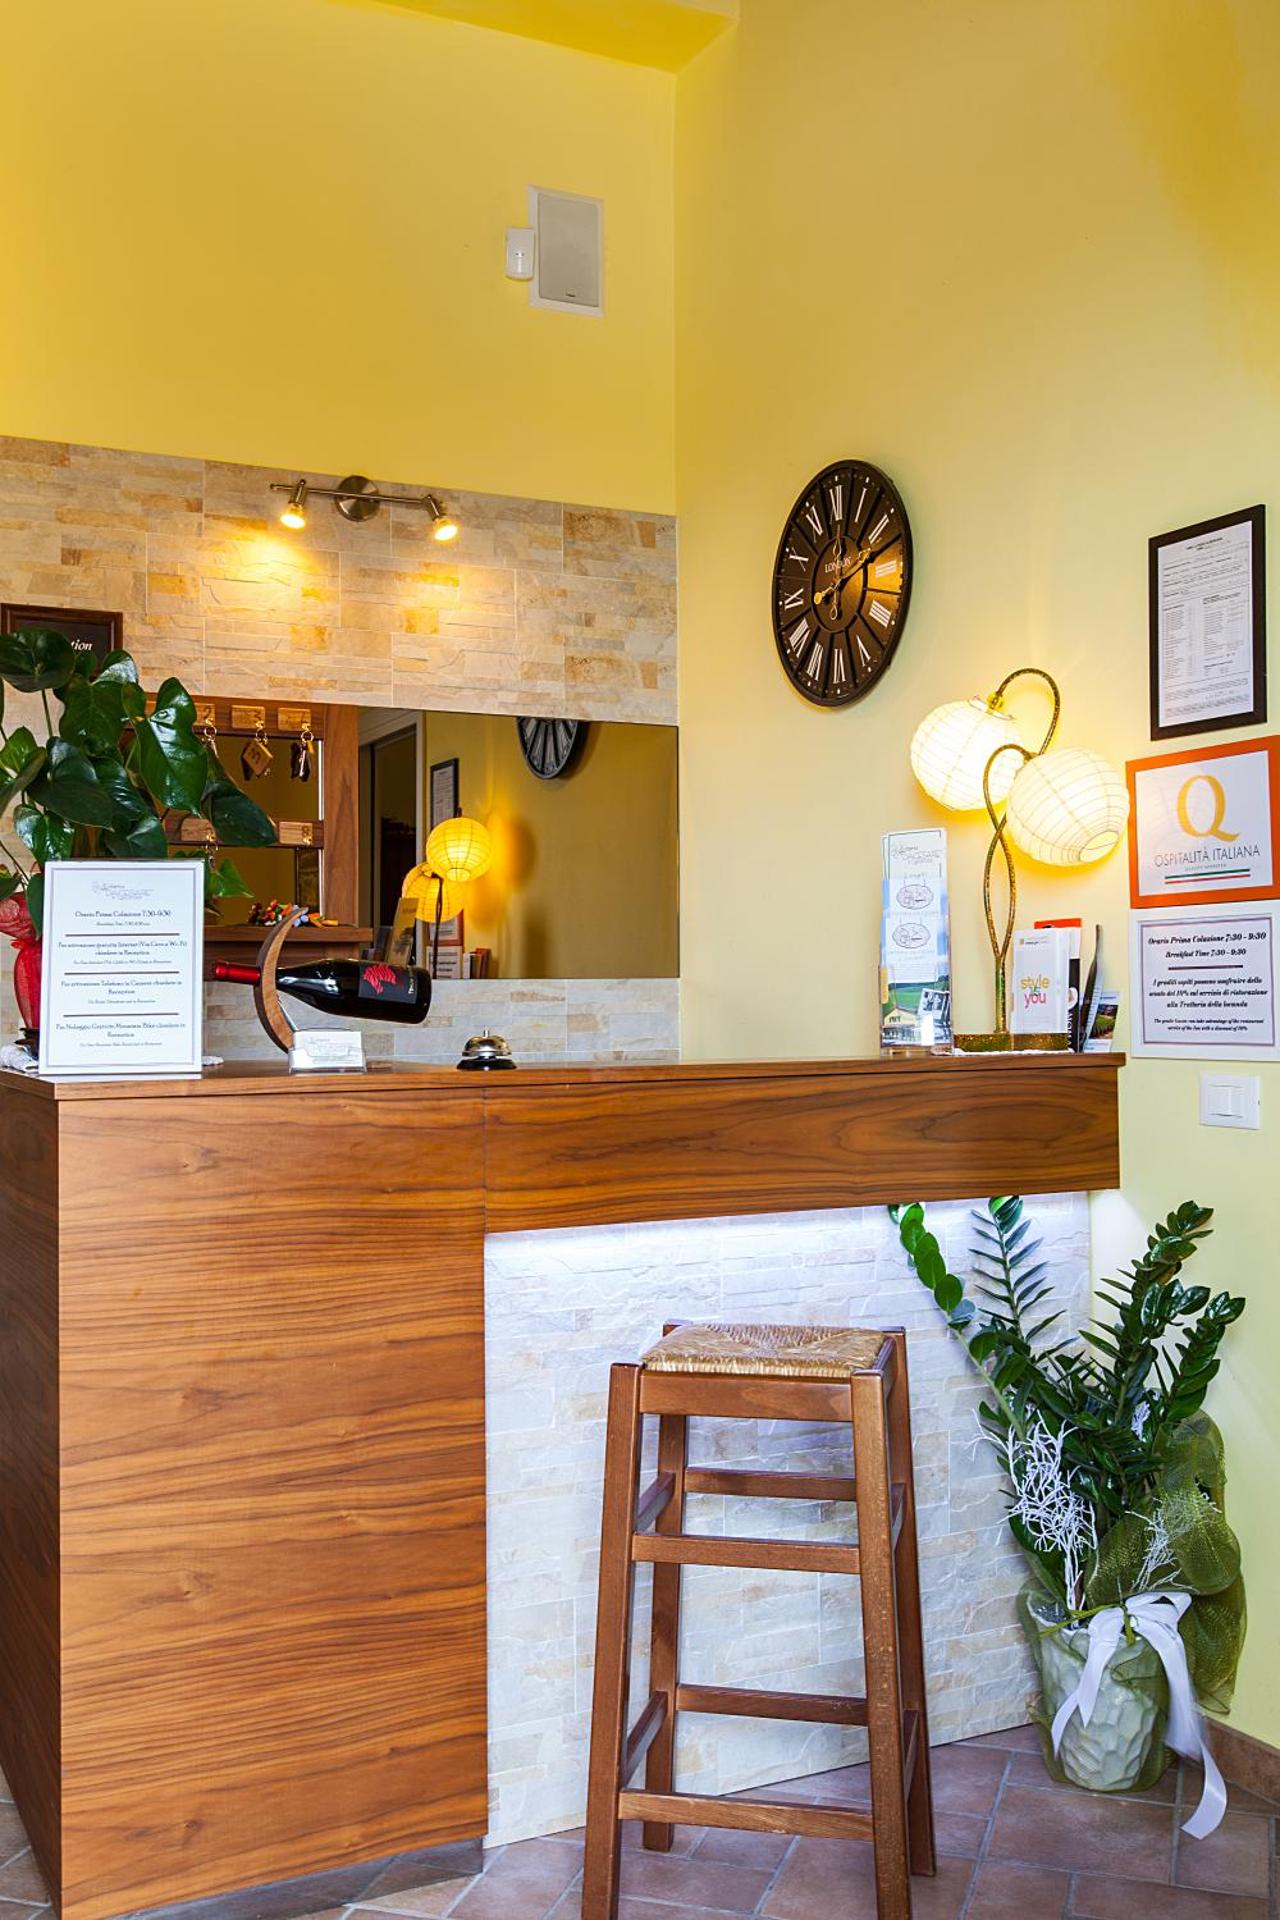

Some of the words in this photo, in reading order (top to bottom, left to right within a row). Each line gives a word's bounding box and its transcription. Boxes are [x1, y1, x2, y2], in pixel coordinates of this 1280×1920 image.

[1176, 774, 1241, 842] Q
[1154, 846, 1210, 868] OSPITALITÀ
[1212, 844, 1260, 861] ITALIANA
[1170, 936, 1191, 944] Prima
[1193, 935, 1224, 943] Colazione
[1165, 950, 1193, 958] Breakfast
[1195, 949, 1210, 957] Time
[1020, 974, 1051, 992] style
[1024, 992, 1047, 1009] you
